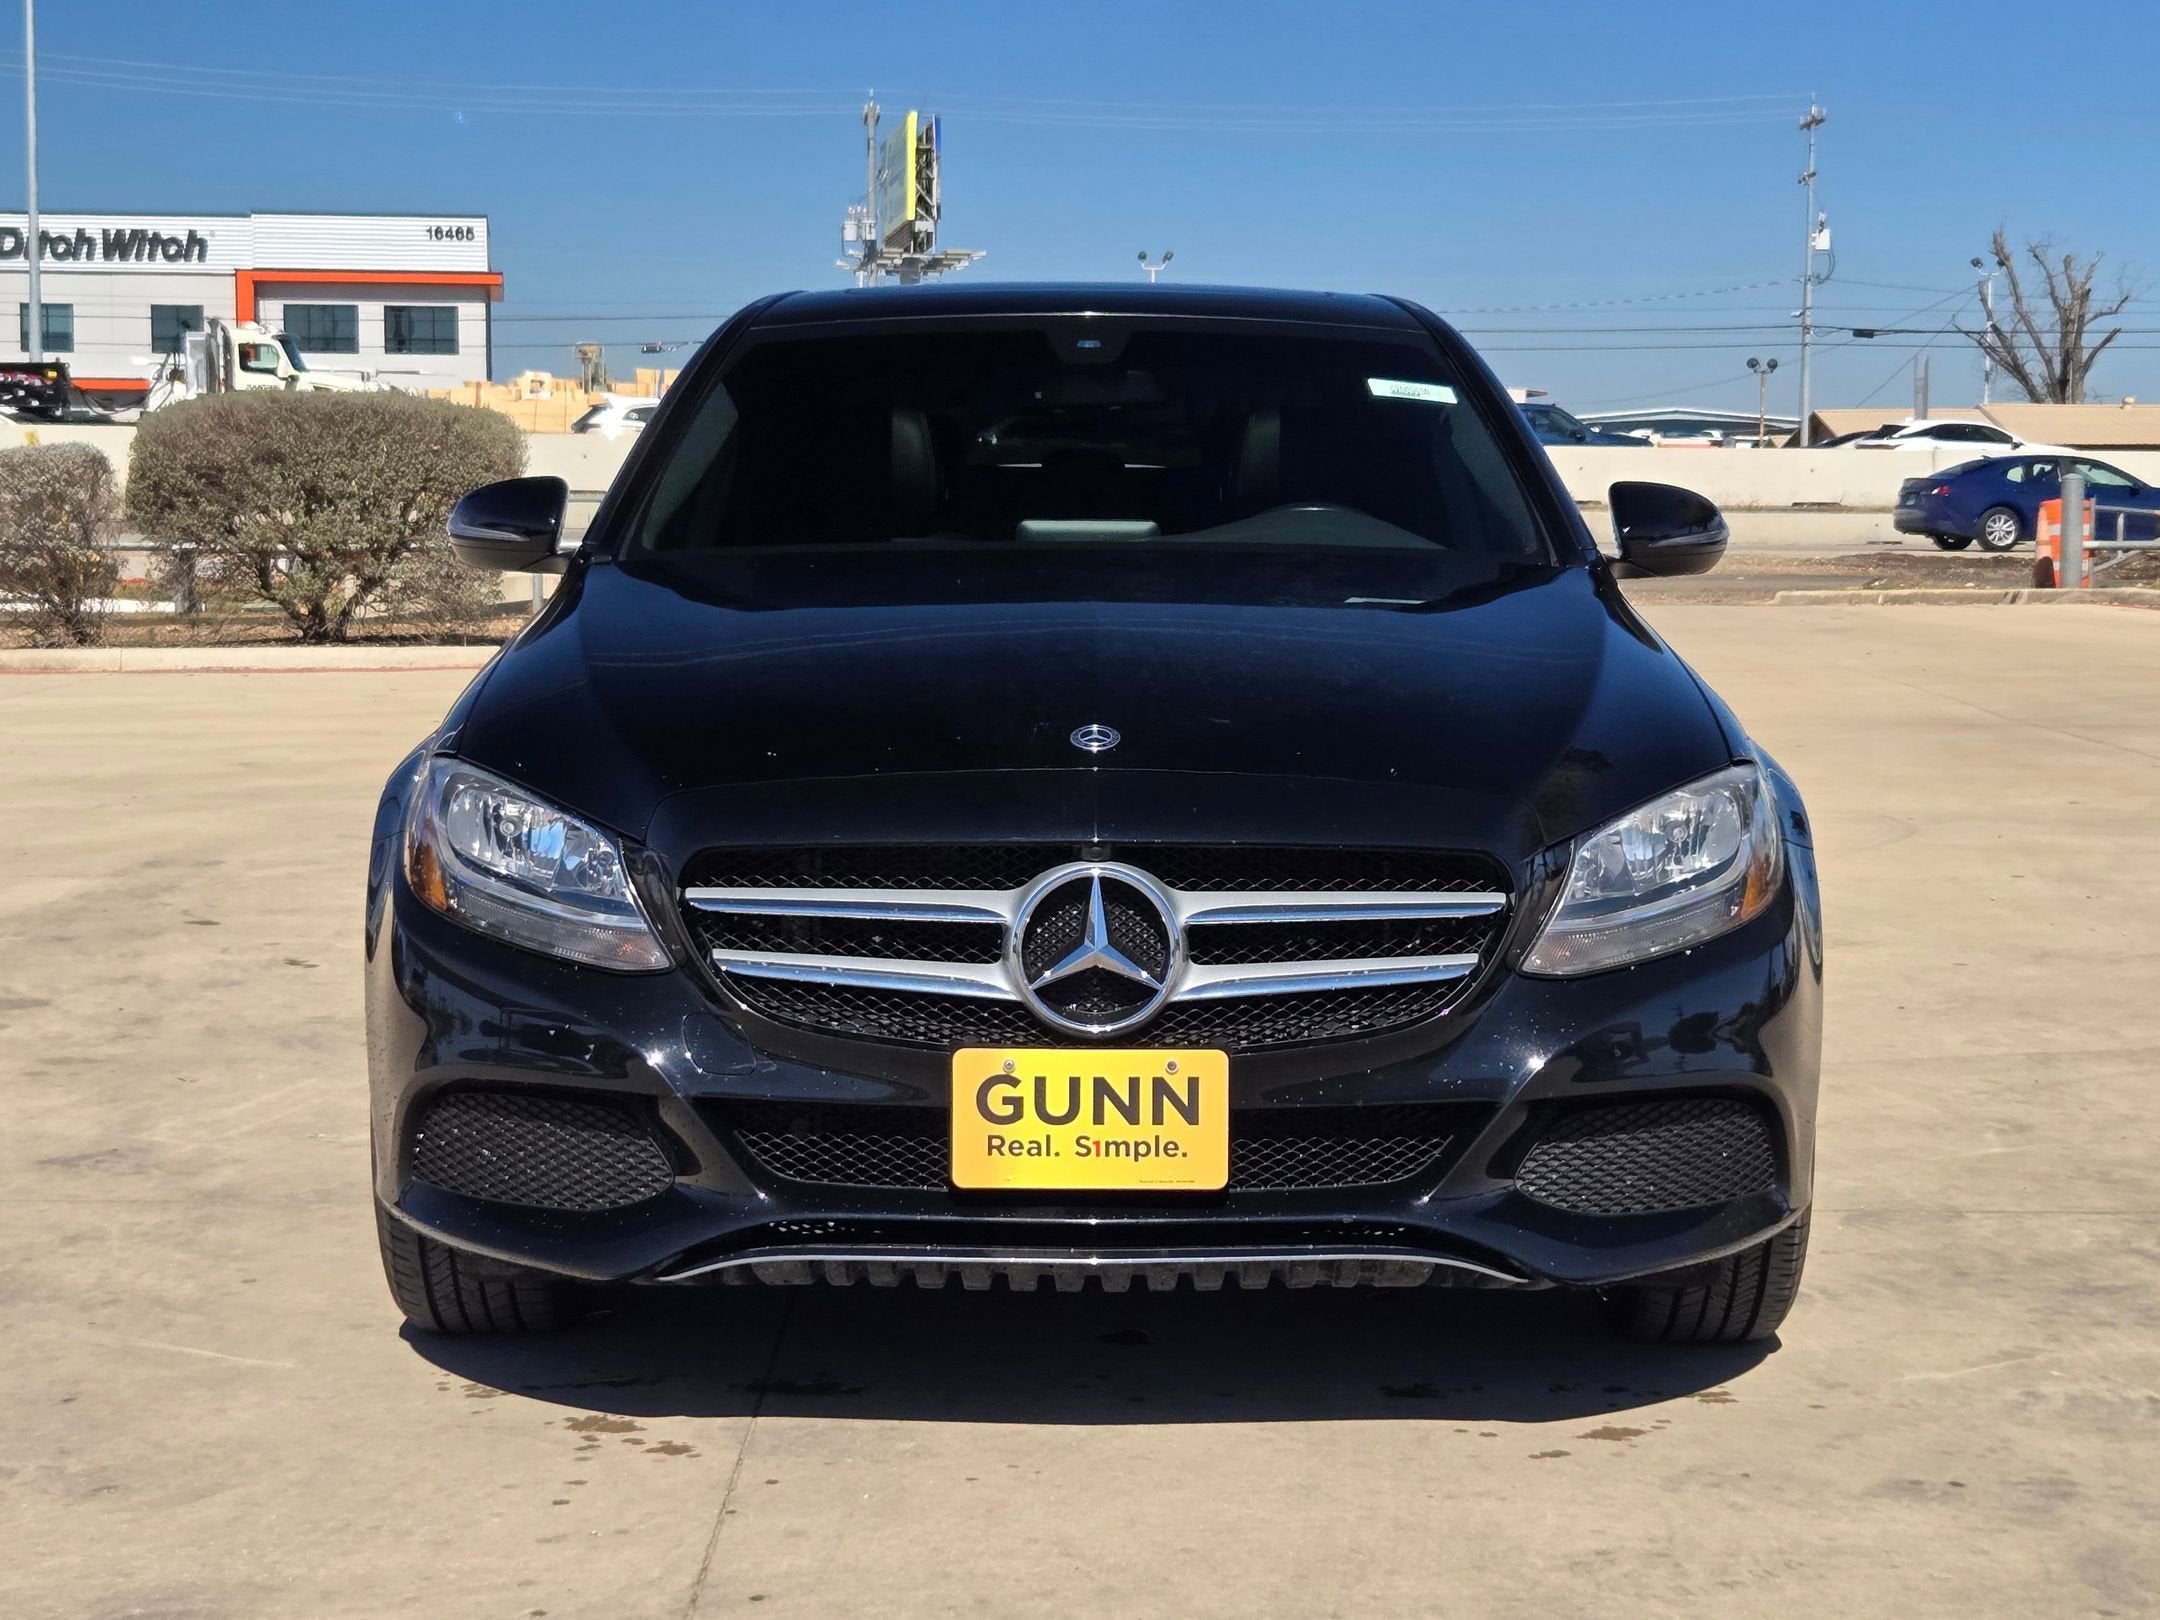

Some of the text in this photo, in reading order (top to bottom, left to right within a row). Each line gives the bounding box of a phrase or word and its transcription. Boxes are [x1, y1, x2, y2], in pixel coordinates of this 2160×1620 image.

[102, 228, 209, 263] Witch
[976, 1074, 1200, 1126] GUNN
[987, 1134, 1060, 1157] Real.
